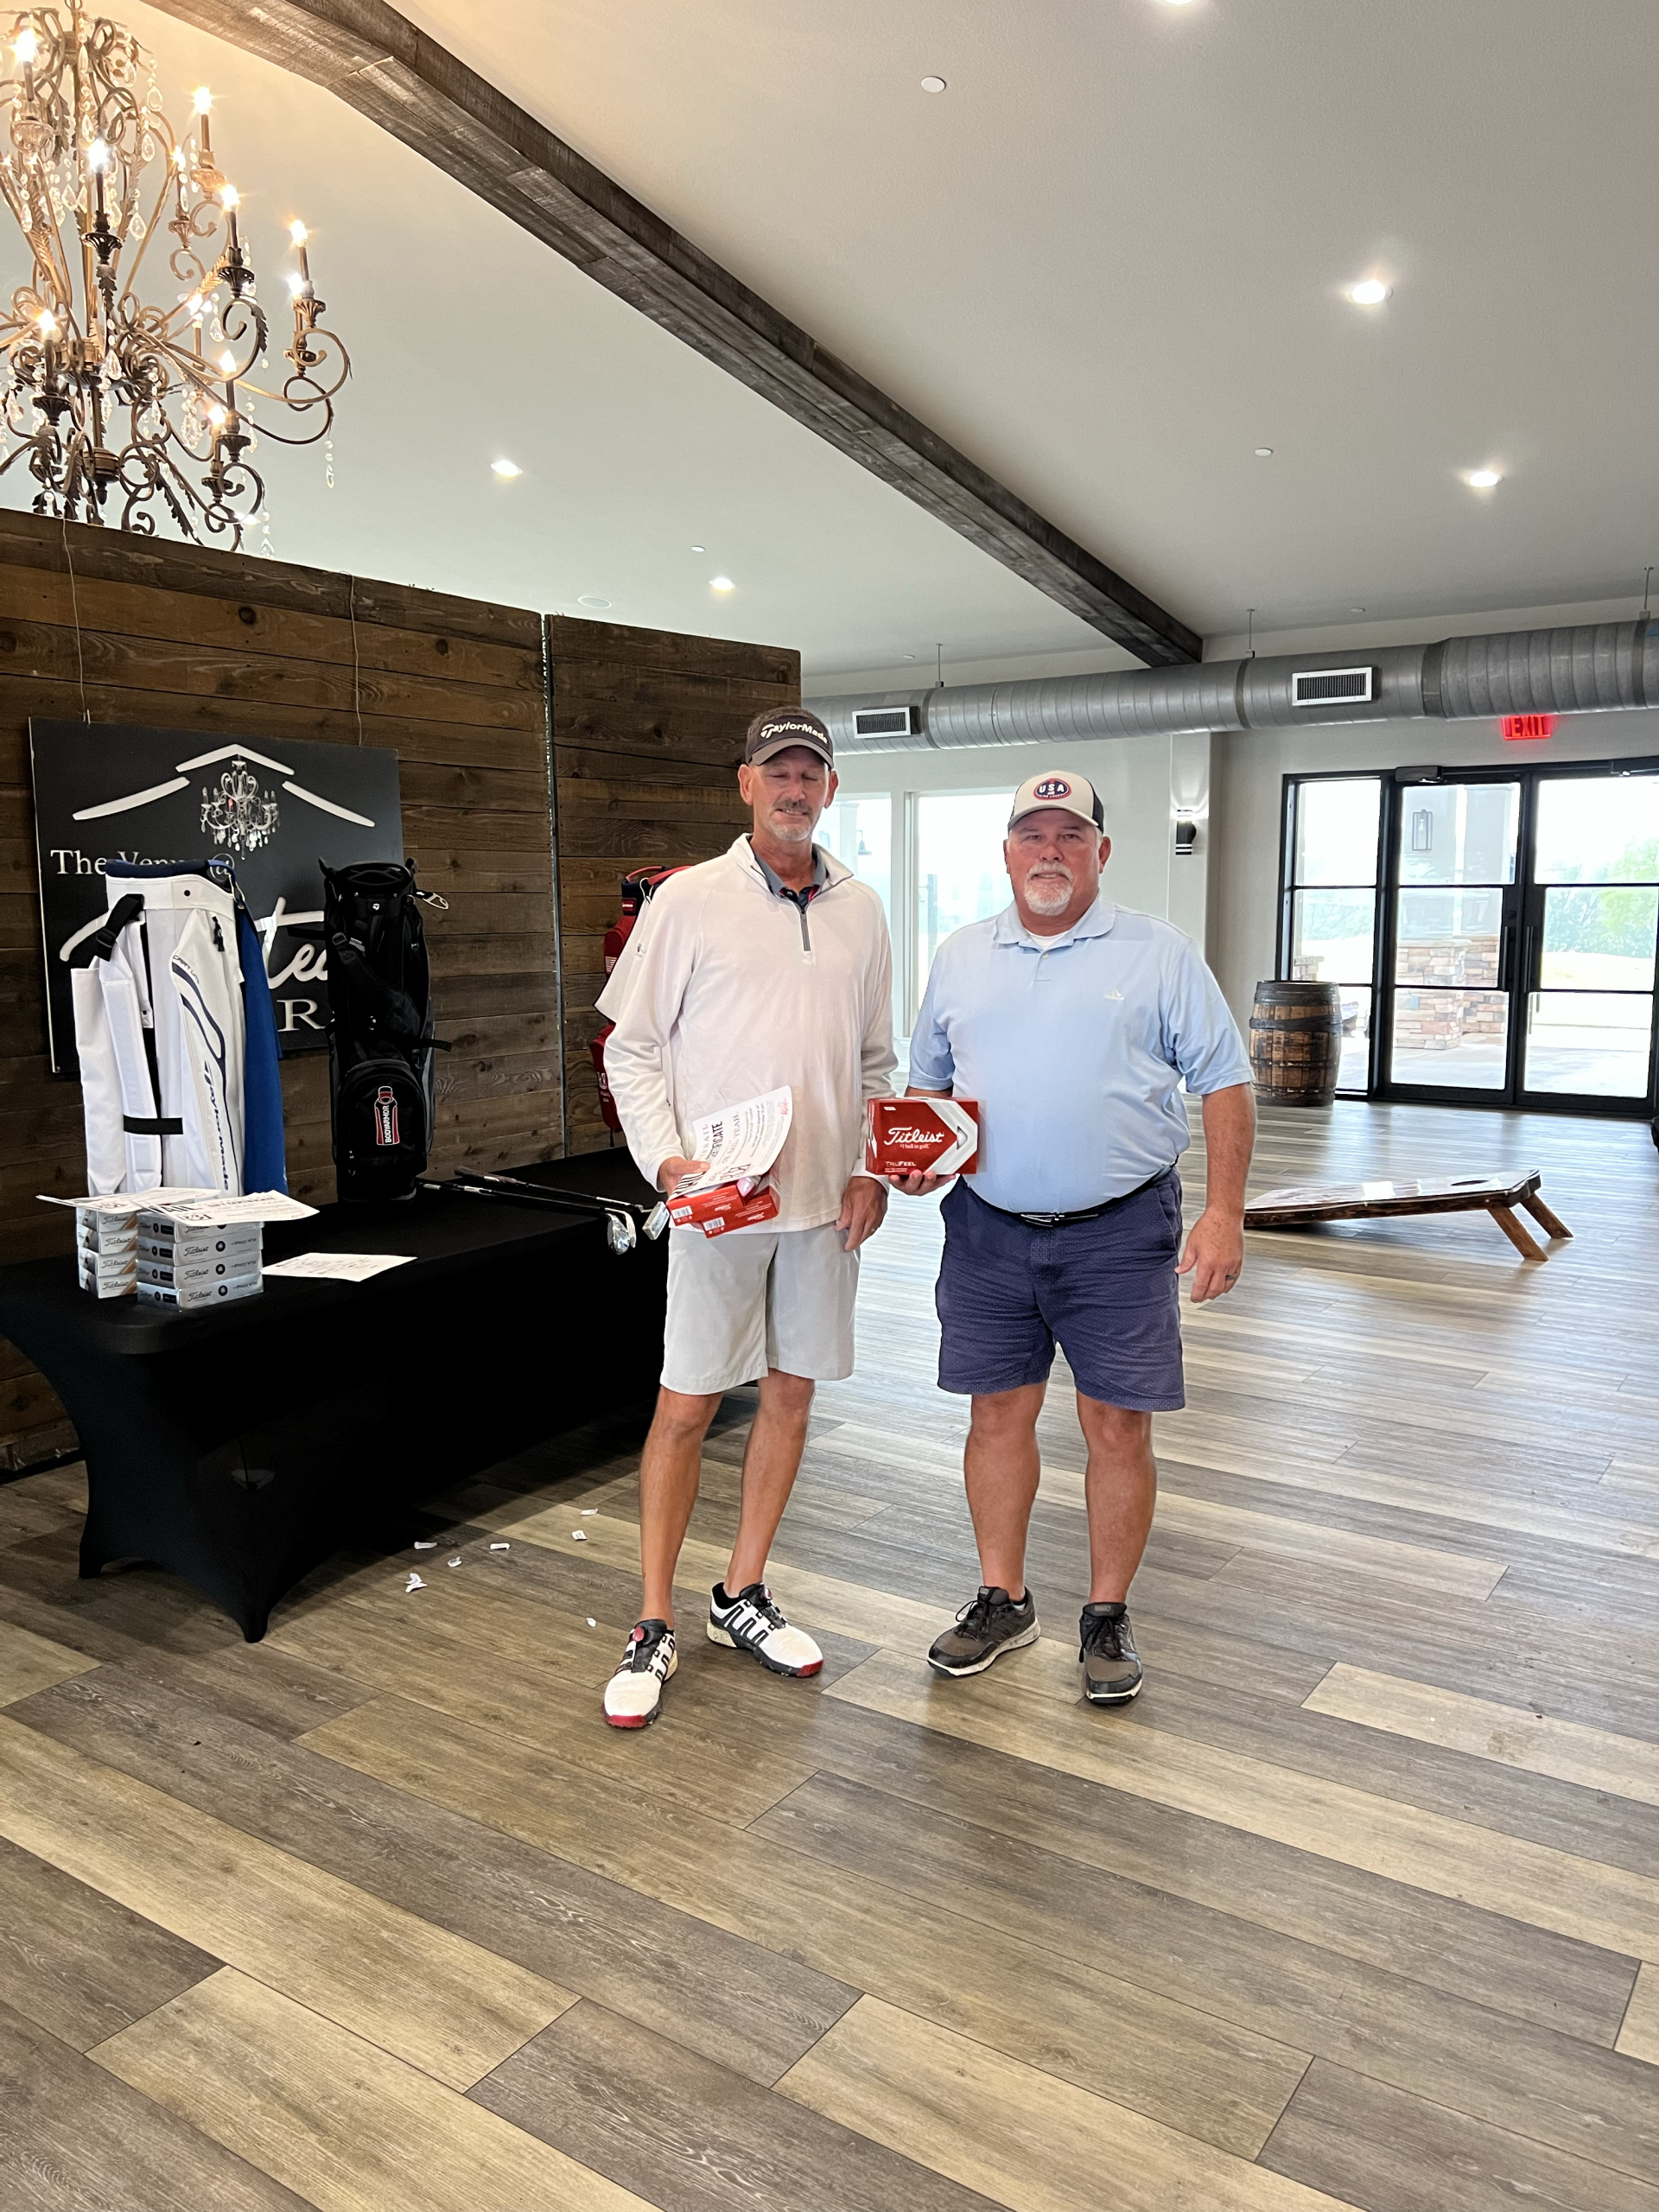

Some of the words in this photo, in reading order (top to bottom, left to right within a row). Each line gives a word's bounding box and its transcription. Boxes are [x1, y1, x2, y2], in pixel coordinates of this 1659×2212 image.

[760, 721, 828, 744] TaylorMade
[1510, 715, 1544, 736] EXIT
[1039, 783, 1065, 793] USA
[50, 849, 106, 874] The
[204, 1060, 229, 1191] TaylorMade
[382, 1105, 392, 1143] BODYARMOR
[884, 1127, 944, 1145] Titleist
[183, 1246, 209, 1256] Titleist
[183, 1269, 209, 1280] Titleist
[188, 1291, 213, 1301] Titleist
